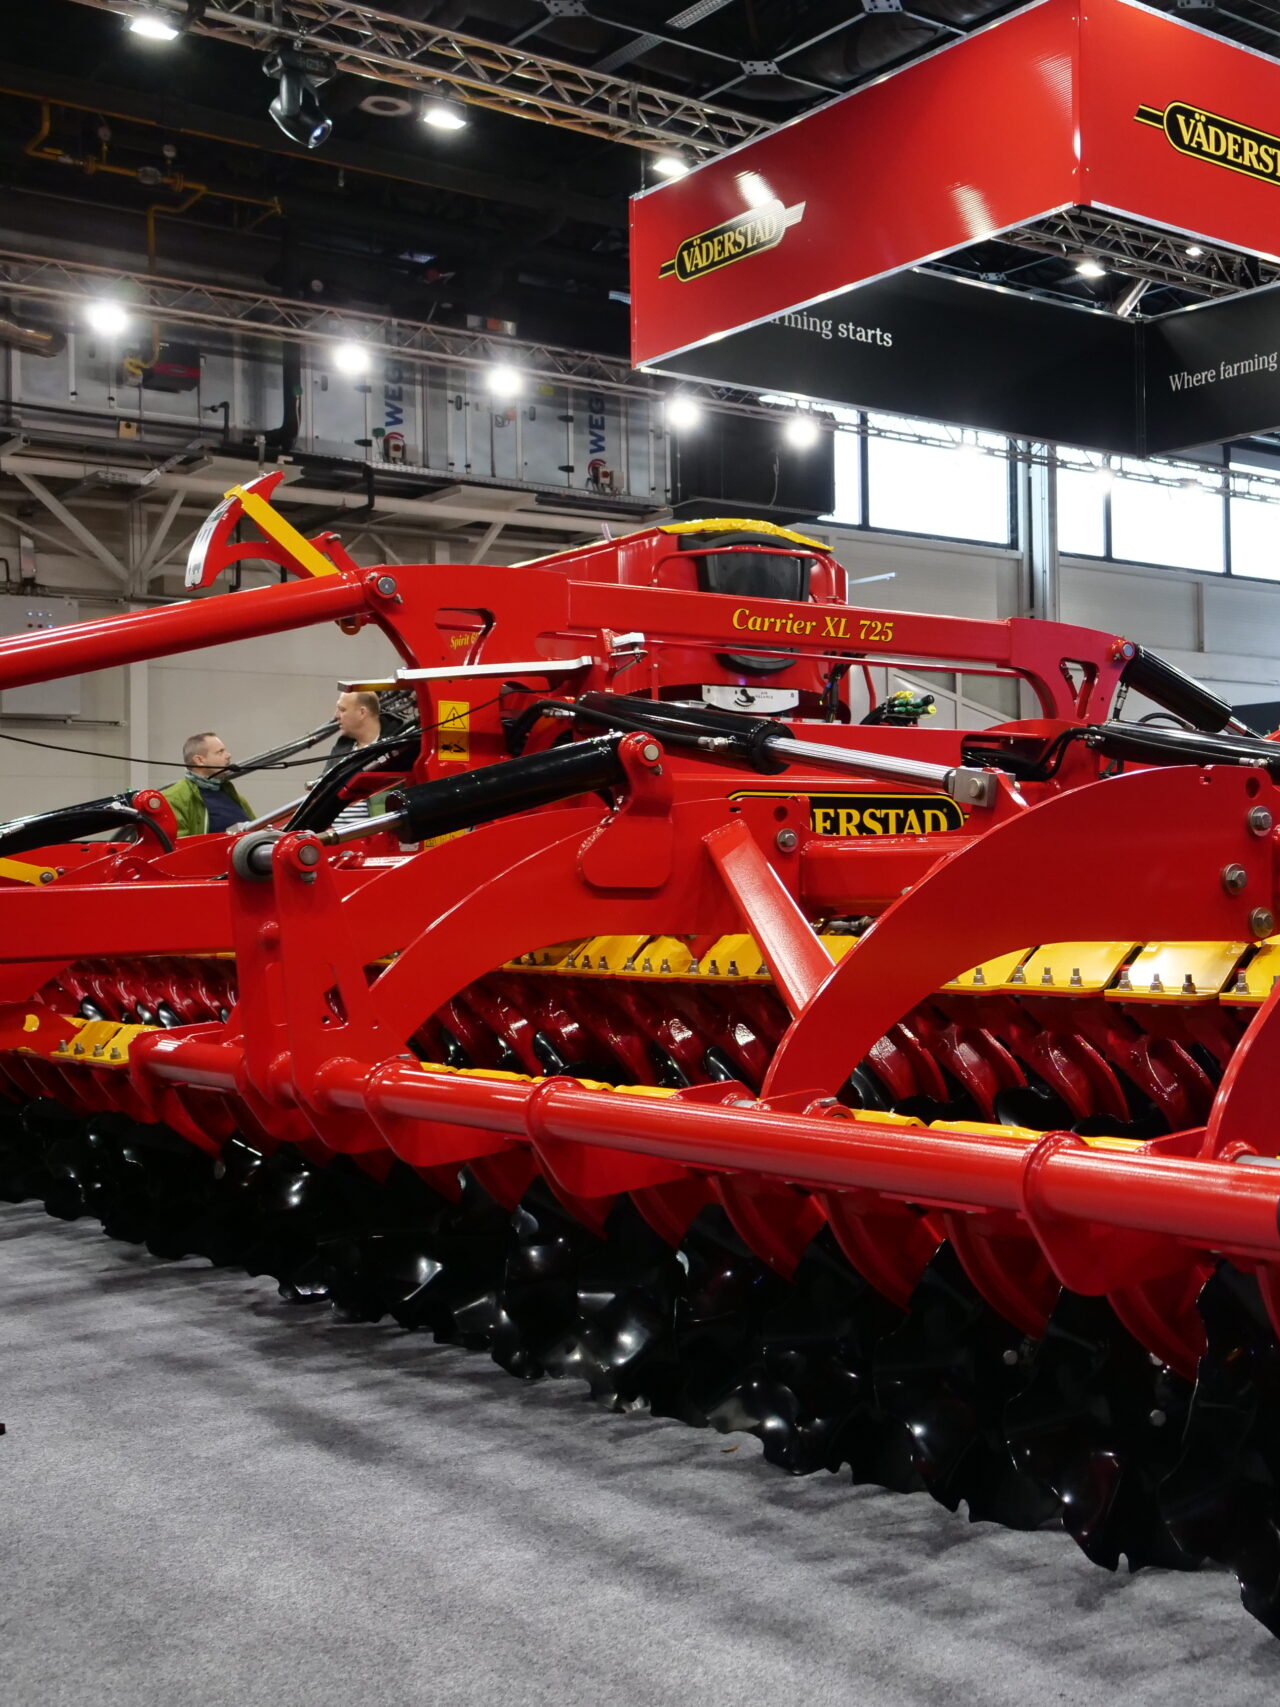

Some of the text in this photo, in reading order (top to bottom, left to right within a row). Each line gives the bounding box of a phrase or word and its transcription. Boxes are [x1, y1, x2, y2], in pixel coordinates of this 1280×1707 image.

[682, 216, 777, 273] VÄDERSTAD
[771, 311, 893, 347] ming starts
[1169, 369, 1216, 392] Where
[1220, 351, 1278, 380] farming
[732, 607, 894, 642] Carrier XL 725
[810, 808, 948, 836] ERSTAD
